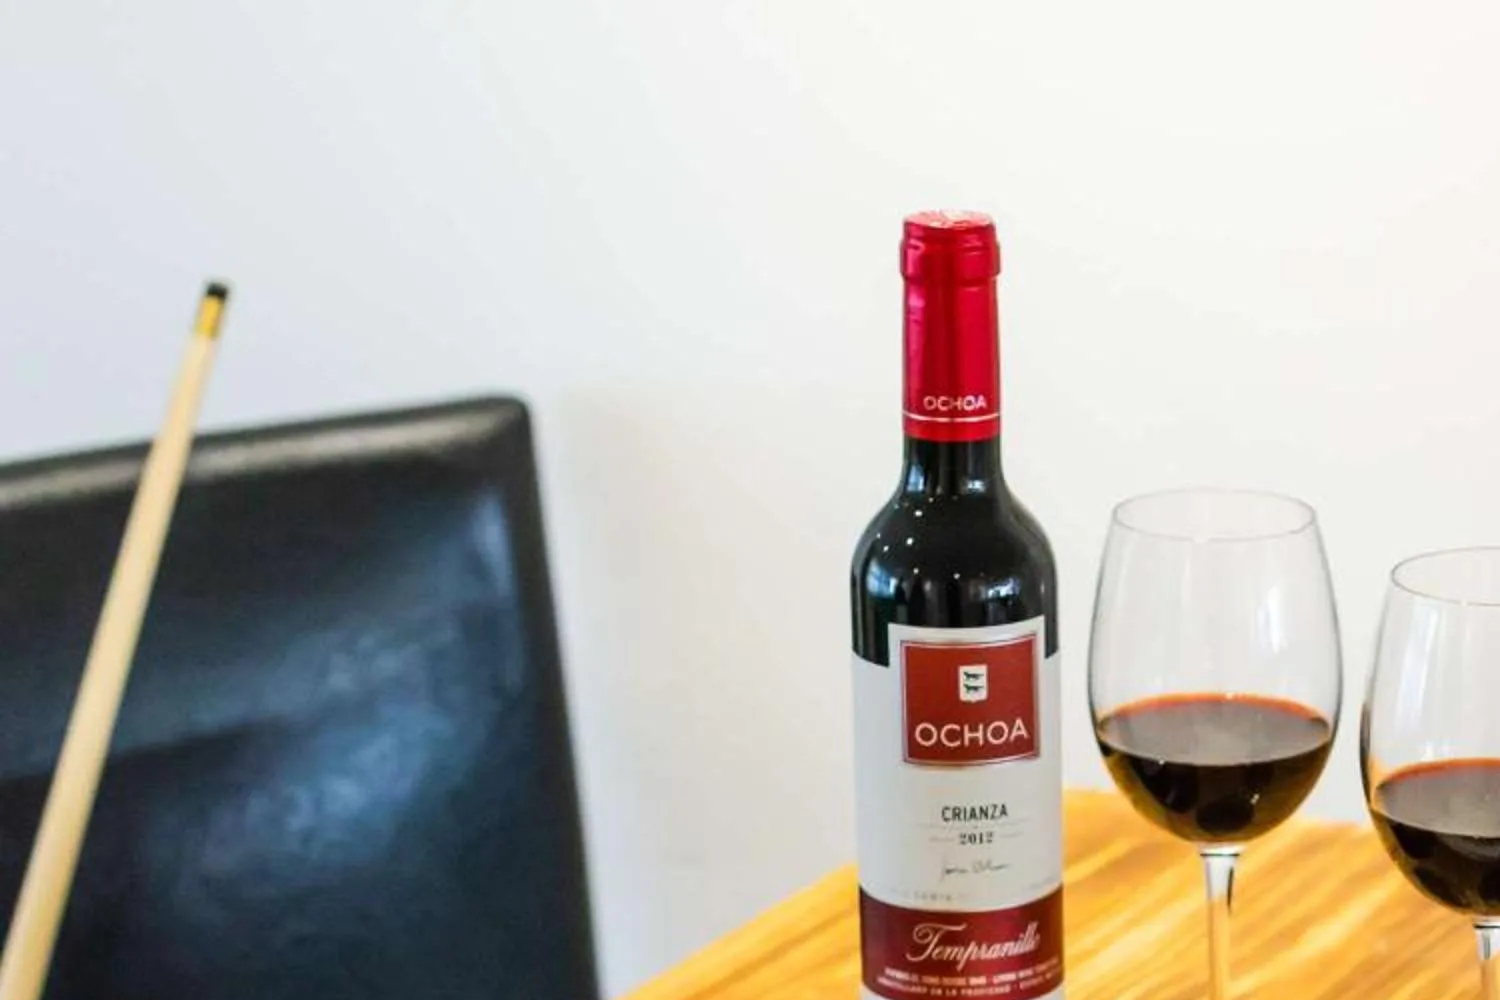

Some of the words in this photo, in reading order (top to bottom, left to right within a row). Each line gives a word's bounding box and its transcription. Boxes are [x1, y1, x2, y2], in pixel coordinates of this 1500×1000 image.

[923, 394, 987, 411] OCHOA
[914, 717, 1030, 748] OCHOA
[941, 804, 1008, 823] CRIANZA
[959, 831, 994, 845] 2012
[906, 921, 1041, 973] Tempranillo
